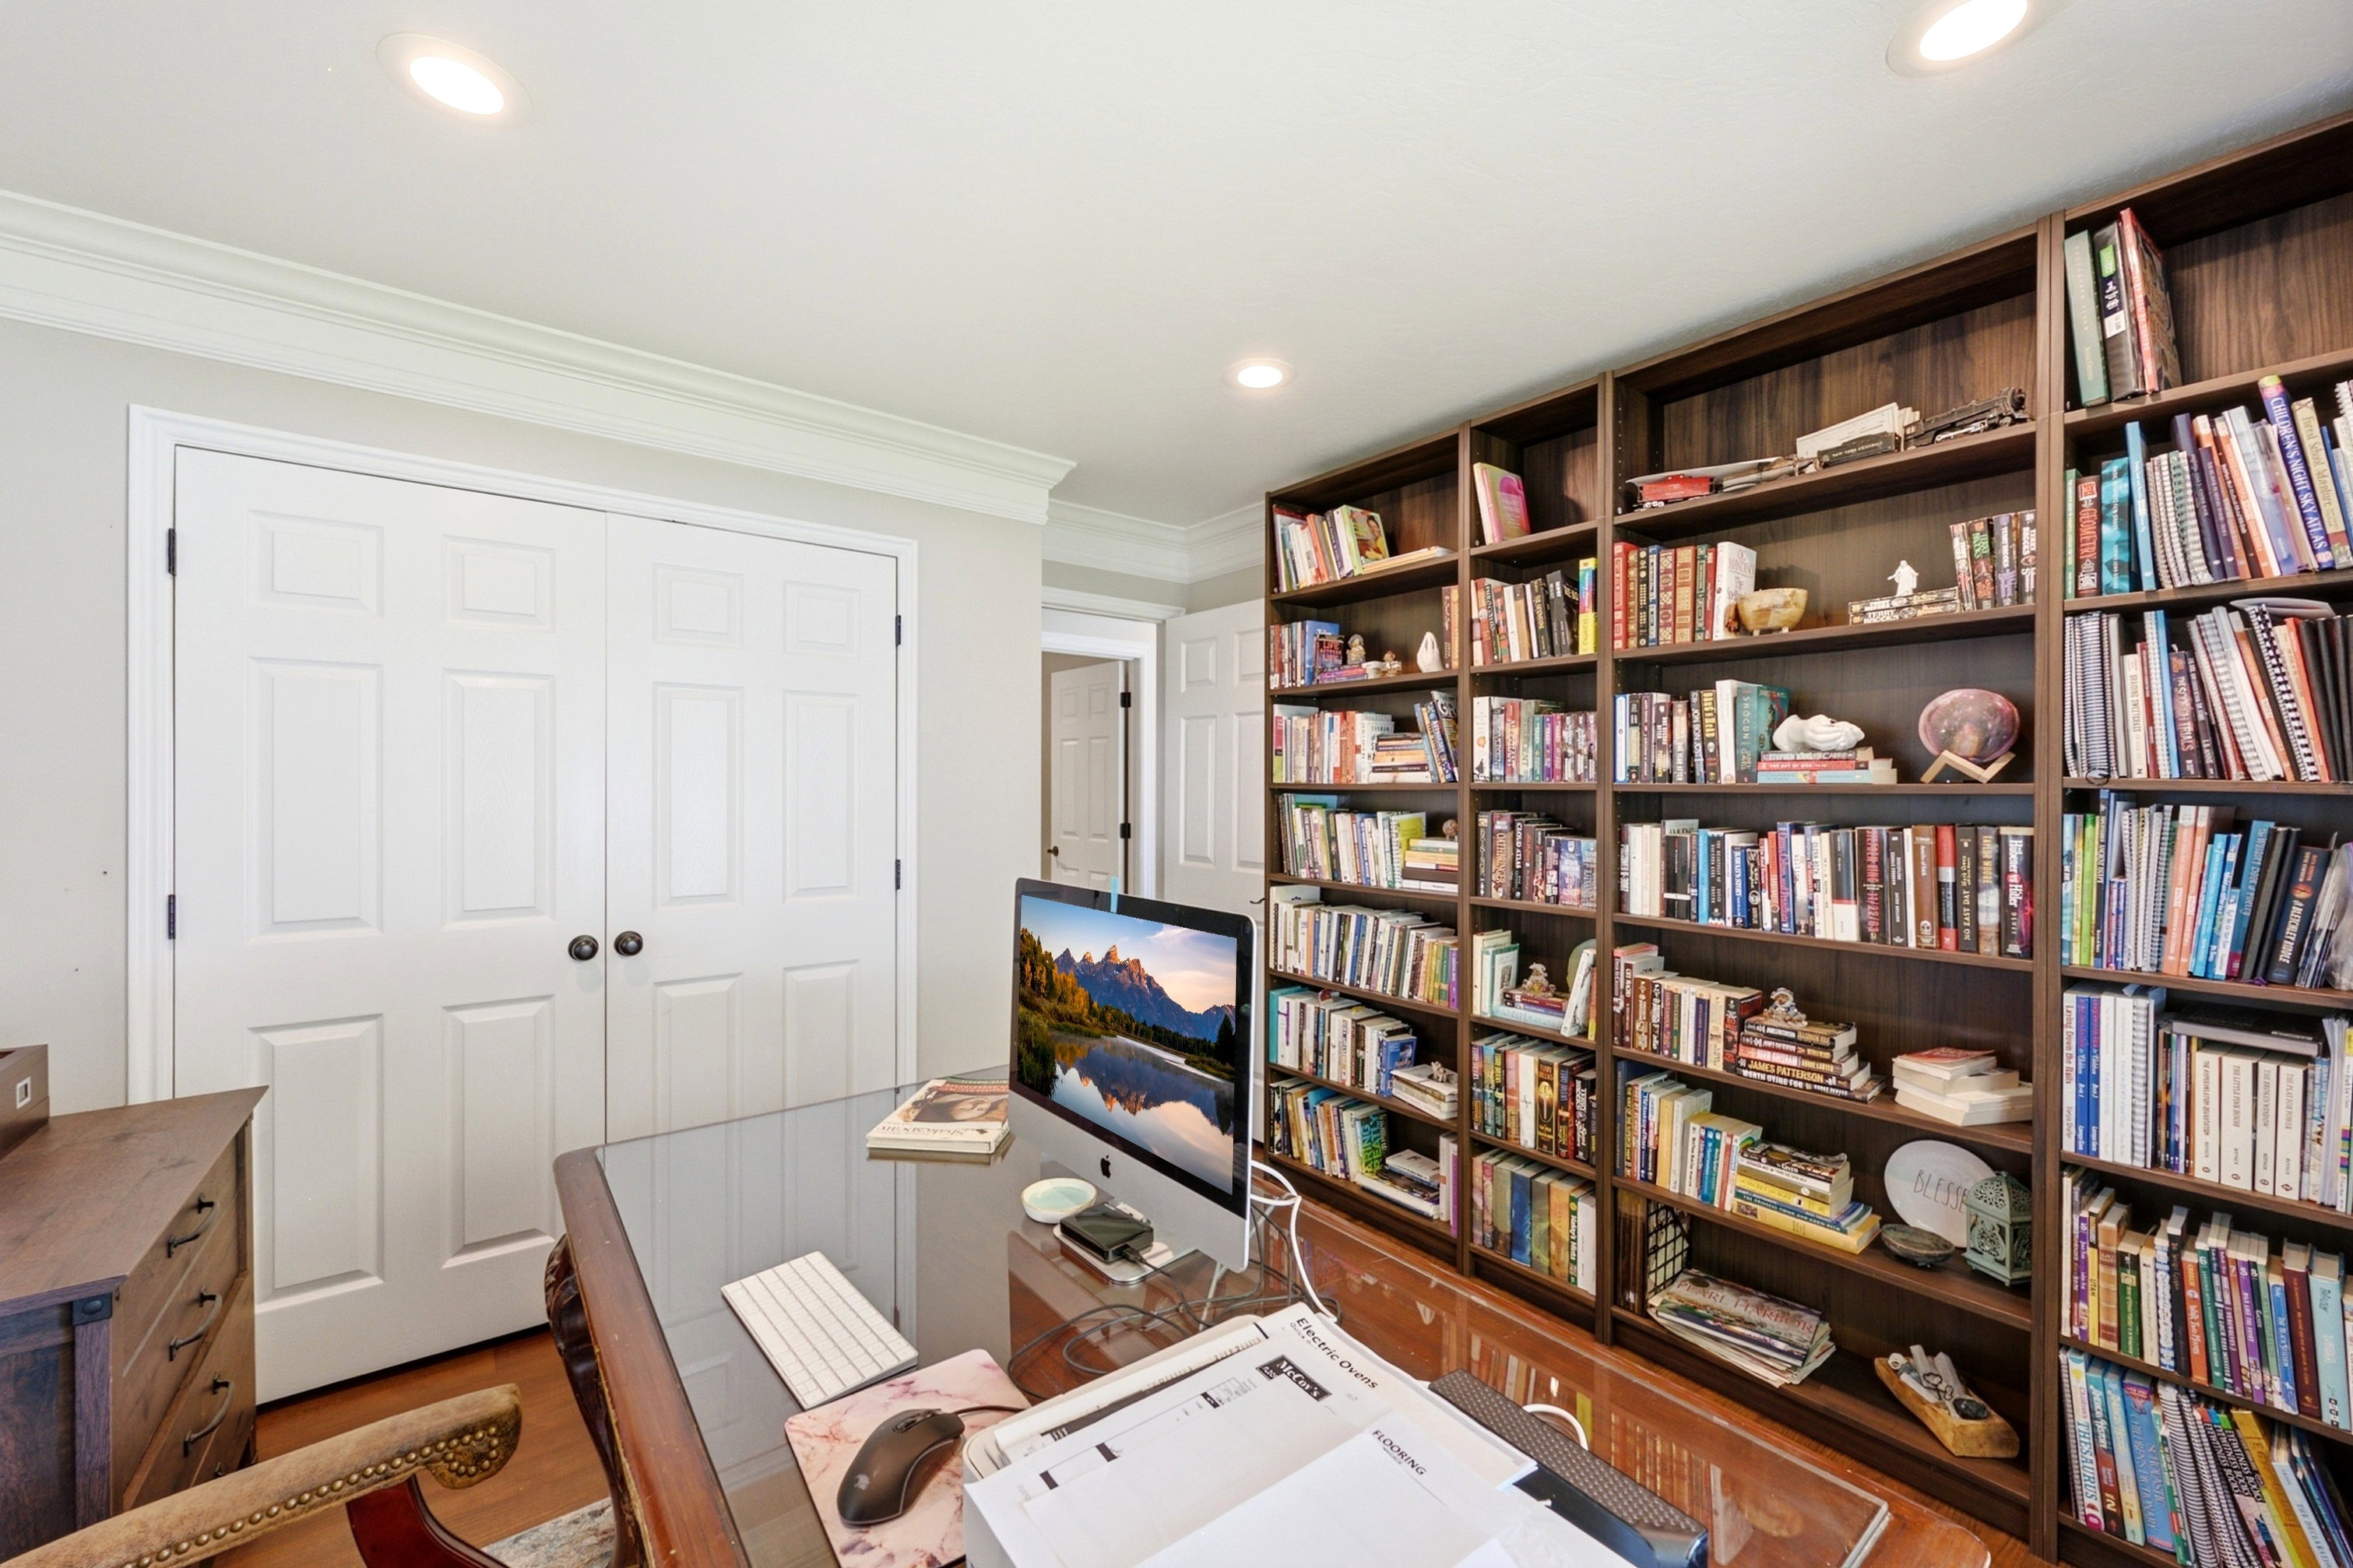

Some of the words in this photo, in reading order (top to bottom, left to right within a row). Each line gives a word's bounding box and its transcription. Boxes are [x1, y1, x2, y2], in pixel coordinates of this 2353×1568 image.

[2270, 397, 2299, 459] CHILDREN'S
[2302, 416, 2316, 440] Forest
[2308, 442, 2322, 467] School
[2291, 459, 2307, 492] NIGHT
[2313, 469, 2333, 508] Adventure
[2298, 494, 2315, 513] SKY
[2079, 508, 2098, 560] GEOMETRY
[2306, 515, 2327, 550] ATLAS
[2130, 699, 2140, 733] SWEETGRASS
[1693, 724, 1701, 740] BON
[2179, 719, 2194, 748] TRIALS
[1694, 741, 1704, 761] JOVI
[2008, 839, 2023, 874] Hübener
[1866, 864, 1879, 883] KING
[2009, 874, 2020, 882] vs
[1734, 878, 1743, 897] STORY
[1962, 888, 1971, 905] DAY
[2009, 884, 2024, 908] Hitler
[1866, 891, 1879, 933] 11/22/63
[1962, 906, 1971, 926] EASY
[2284, 905, 2304, 940] BLETCHLEY
[1963, 928, 1971, 940] NO
[2279, 940, 2295, 964] RIDDLE
[2064, 1004, 2074, 1028] Laying
[2065, 1030, 2074, 1051] Down
[2066, 1052, 2074, 1064] the
[2232, 1064, 2241, 1075] THE
[1742, 1070, 1766, 1081] WORTH
[1767, 1074, 1788, 1086] DYING
[1788, 1078, 1804, 1090] FOR
[1748, 1059, 1775, 1074] JAMES
[1776, 1063, 1824, 1085] PATTERSON
[2263, 1069, 2271, 1080] THE
[2285, 1073, 2294, 1083] THE
[2232, 1076, 2241, 1095] LITTLE
[2285, 1083, 2294, 1099] PLAY
[2232, 1095, 2241, 1109] PINK
[2284, 1098, 2294, 1109] FOR
[2232, 1109, 2241, 1127] HOUSE
[2284, 1109, 2294, 1130] POWER
[1913, 1169, 1970, 1215] BLESSE
[2199, 1256, 2207, 1266] 6
[2187, 1263, 2196, 1287] CREECH
[1676, 1279, 1727, 1304] PEARL
[1733, 1299, 1813, 1334] HARBOR
[2188, 1305, 2199, 1320] Walk
[2189, 1320, 2200, 1332] Two
[1296, 1317, 1339, 1361] Electric
[1338, 1359, 1379, 1390] Ovens
[2190, 1333, 2203, 1355] Moons
[2221, 1349, 2231, 1376] MONSTER
[1276, 1361, 1321, 1399] McCoy's
[1371, 1429, 1427, 1475] FLOORING
[2077, 1420, 2098, 1501] THESAURUS
[2204, 1422, 2230, 1467] EYEWITNESS
[2223, 1468, 2242, 1494] BOOKS
[2214, 1424, 2242, 1469] EYEWITNESS
[2233, 1468, 2253, 1496] BOOKS
[2149, 1443, 2165, 1503] SCHOLASTIC
[2225, 1429, 2253, 1475] EYEWITNESS
[2246, 1475, 2267, 1503] BOOKS
[2296, 1503, 2310, 1520] THE
